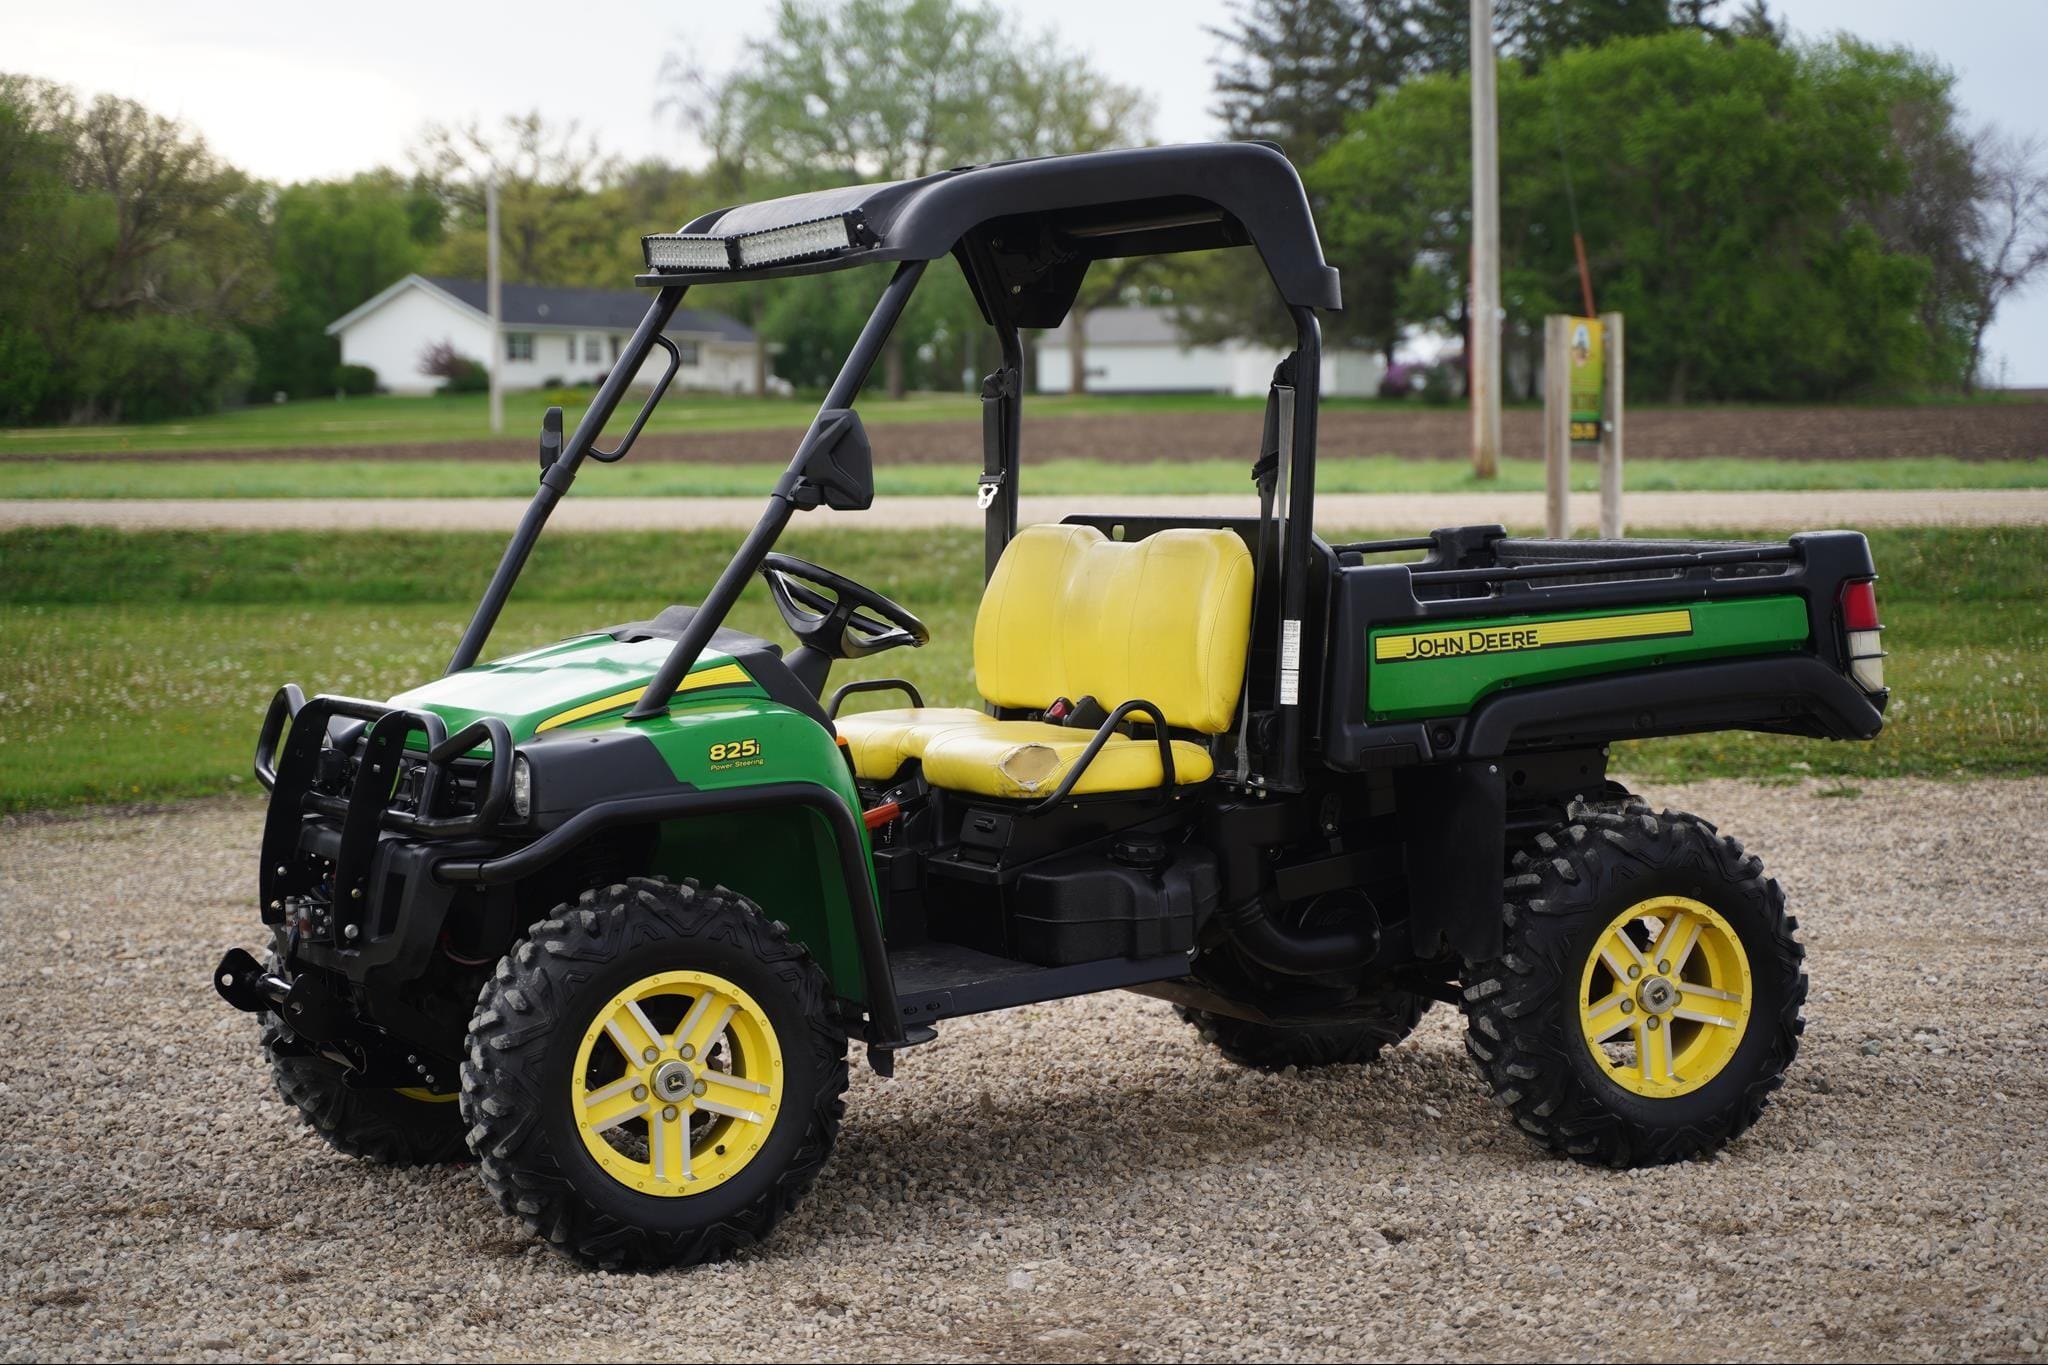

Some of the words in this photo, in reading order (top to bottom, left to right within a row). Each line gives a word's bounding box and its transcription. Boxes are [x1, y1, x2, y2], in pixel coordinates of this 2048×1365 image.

[1406, 636, 1464, 657] JOHN
[1469, 630, 1539, 651] DEERE
[709, 739, 760, 761] 825i
[710, 763, 733, 771] Power
[735, 758, 764, 768] Steering
